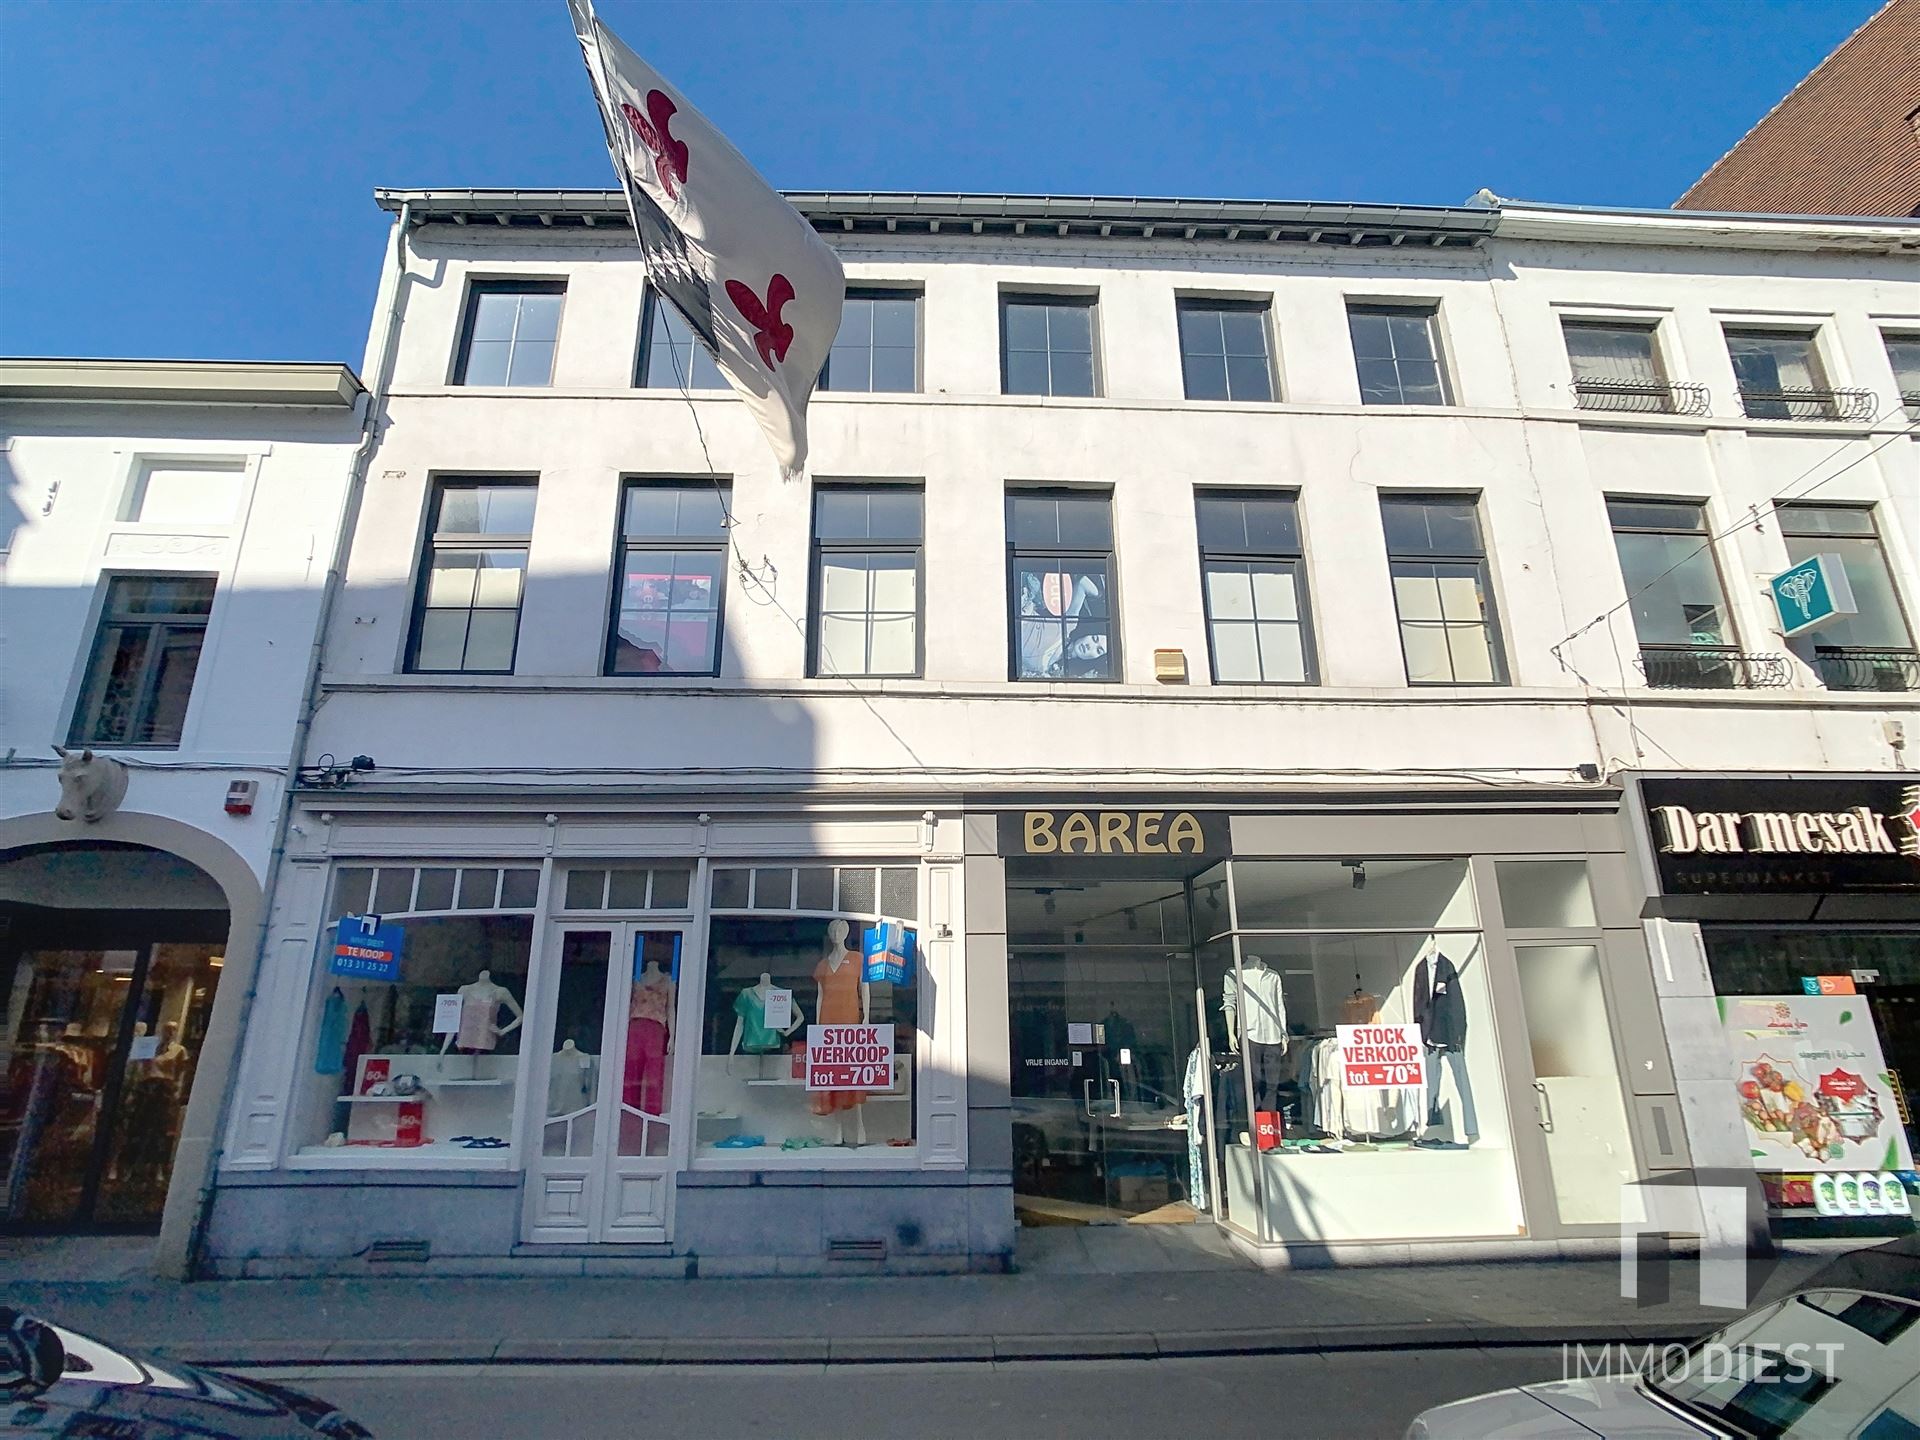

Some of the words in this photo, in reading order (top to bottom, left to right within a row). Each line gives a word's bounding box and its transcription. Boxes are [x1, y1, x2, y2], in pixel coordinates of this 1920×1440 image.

[1023, 811, 1205, 854] BAREA
[1651, 805, 1742, 854] Dar
[1749, 805, 1896, 854] mesak
[347, 946, 358, 956] TE
[359, 947, 384, 960] KOOP
[337, 958, 353, 968] 013
[367, 961, 377, 970] 25
[823, 1028, 879, 1045] STOCK
[1353, 1028, 1406, 1045] STOCK
[811, 1047, 890, 1063] VERKOOP
[1343, 1046, 1418, 1063] VERKOOP
[814, 1072, 834, 1085] tot
[840, 1066, 886, 1085] -70%
[1348, 1072, 1369, 1085] tot
[1374, 1064, 1419, 1084] -70%
